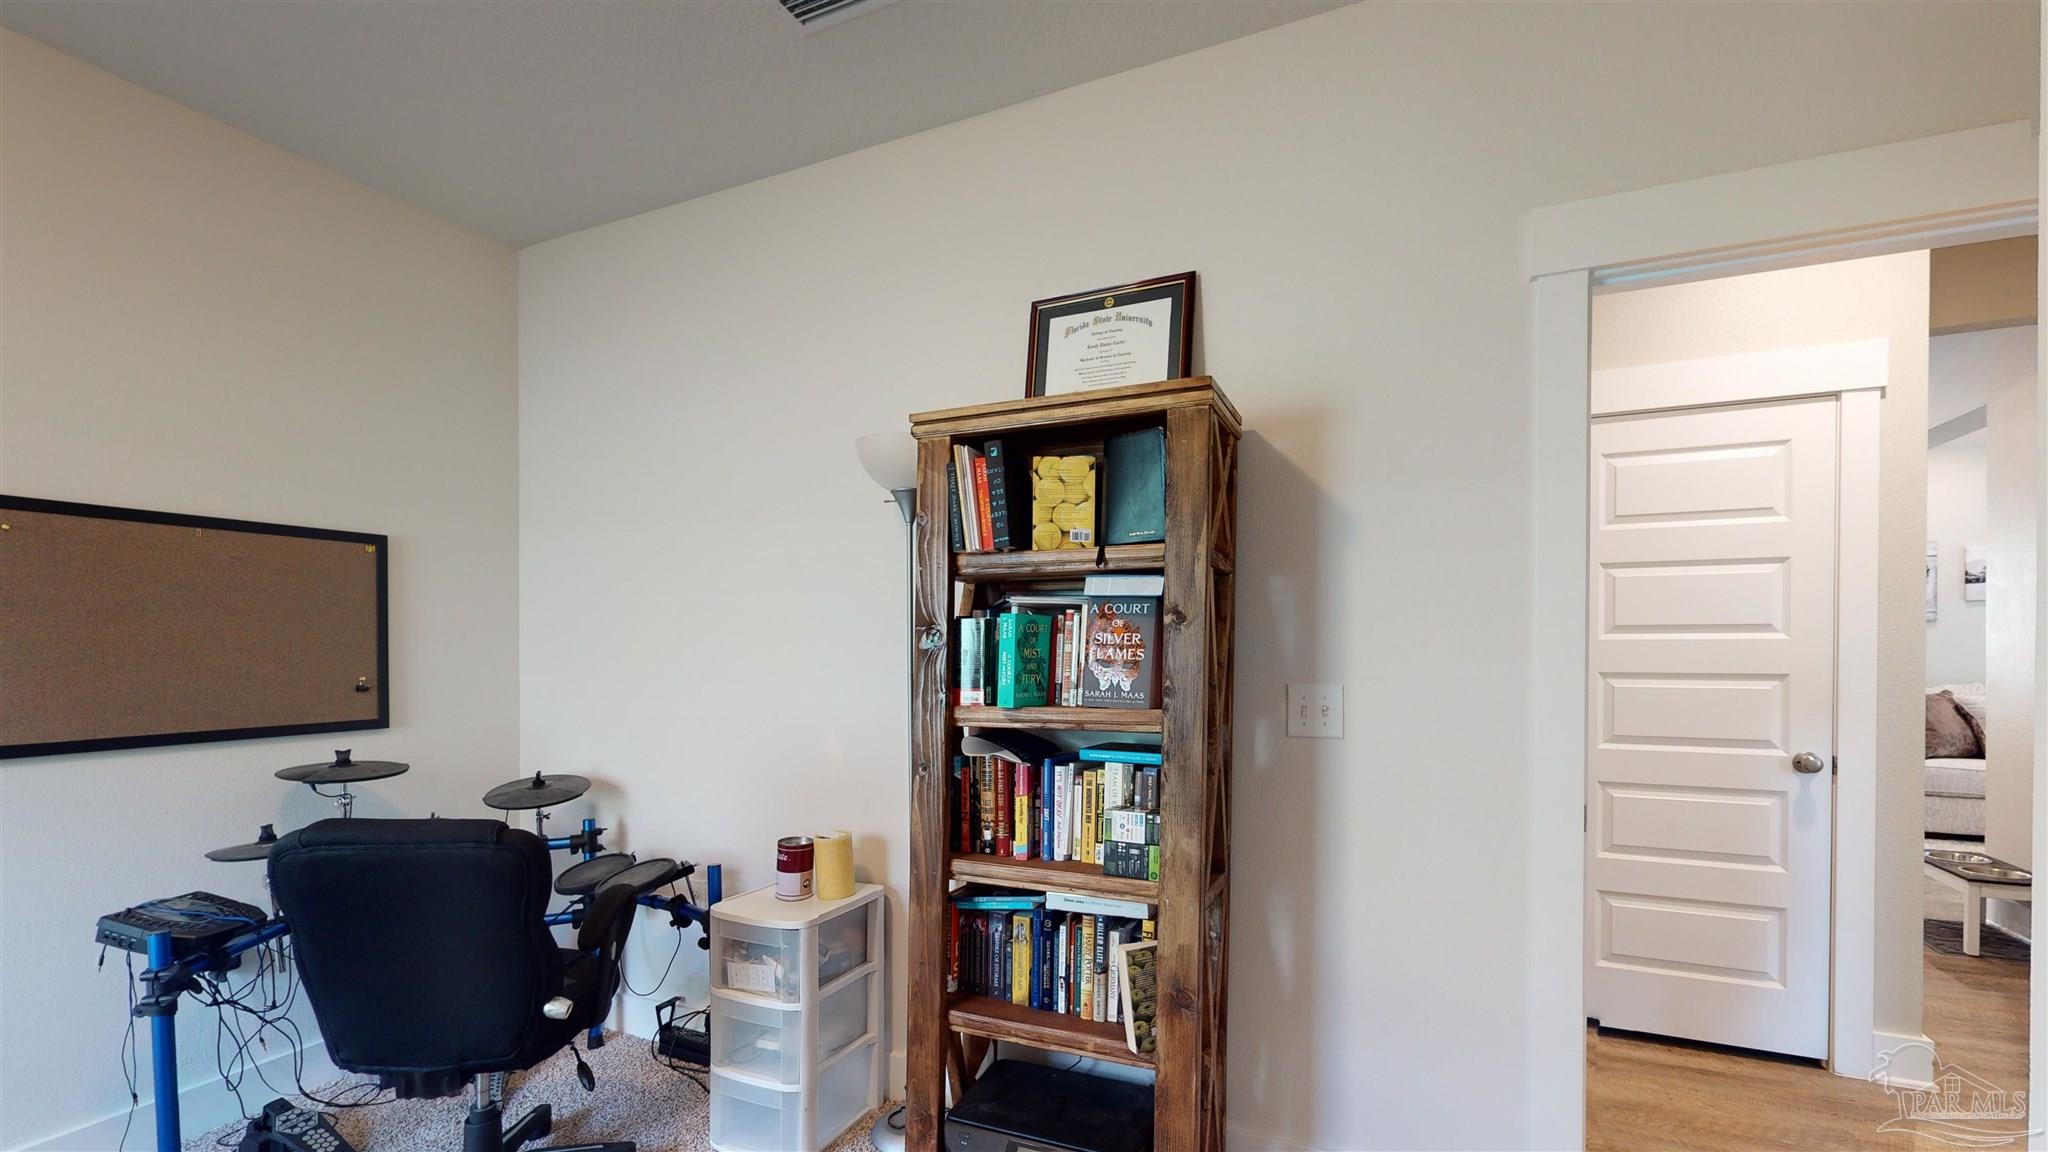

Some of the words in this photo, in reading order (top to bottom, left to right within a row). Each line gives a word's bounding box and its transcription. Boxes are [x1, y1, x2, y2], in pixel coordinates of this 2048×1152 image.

[1063, 321, 1090, 339] Florida
[1092, 315, 1113, 326] State
[1115, 311, 1153, 327] University
[1090, 604, 1100, 614] A
[1104, 603, 1150, 614] COURT
[1018, 624, 1024, 633] A
[1026, 623, 1049, 633] COURT
[1112, 619, 1125, 627] OF
[1094, 632, 1141, 645] SILVER
[1023, 648, 1041, 659] MIST
[1089, 648, 1145, 660] FLAMES
[1021, 674, 1042, 684] FURY
[1085, 690, 1111, 698] SARAH
[1121, 691, 1145, 699] MAAS
[1096, 922, 1104, 945] KILLER
[1084, 933, 1092, 957] HARRY
[1096, 946, 1104, 964] ELITE
[1084, 958, 1092, 984] POTTER
